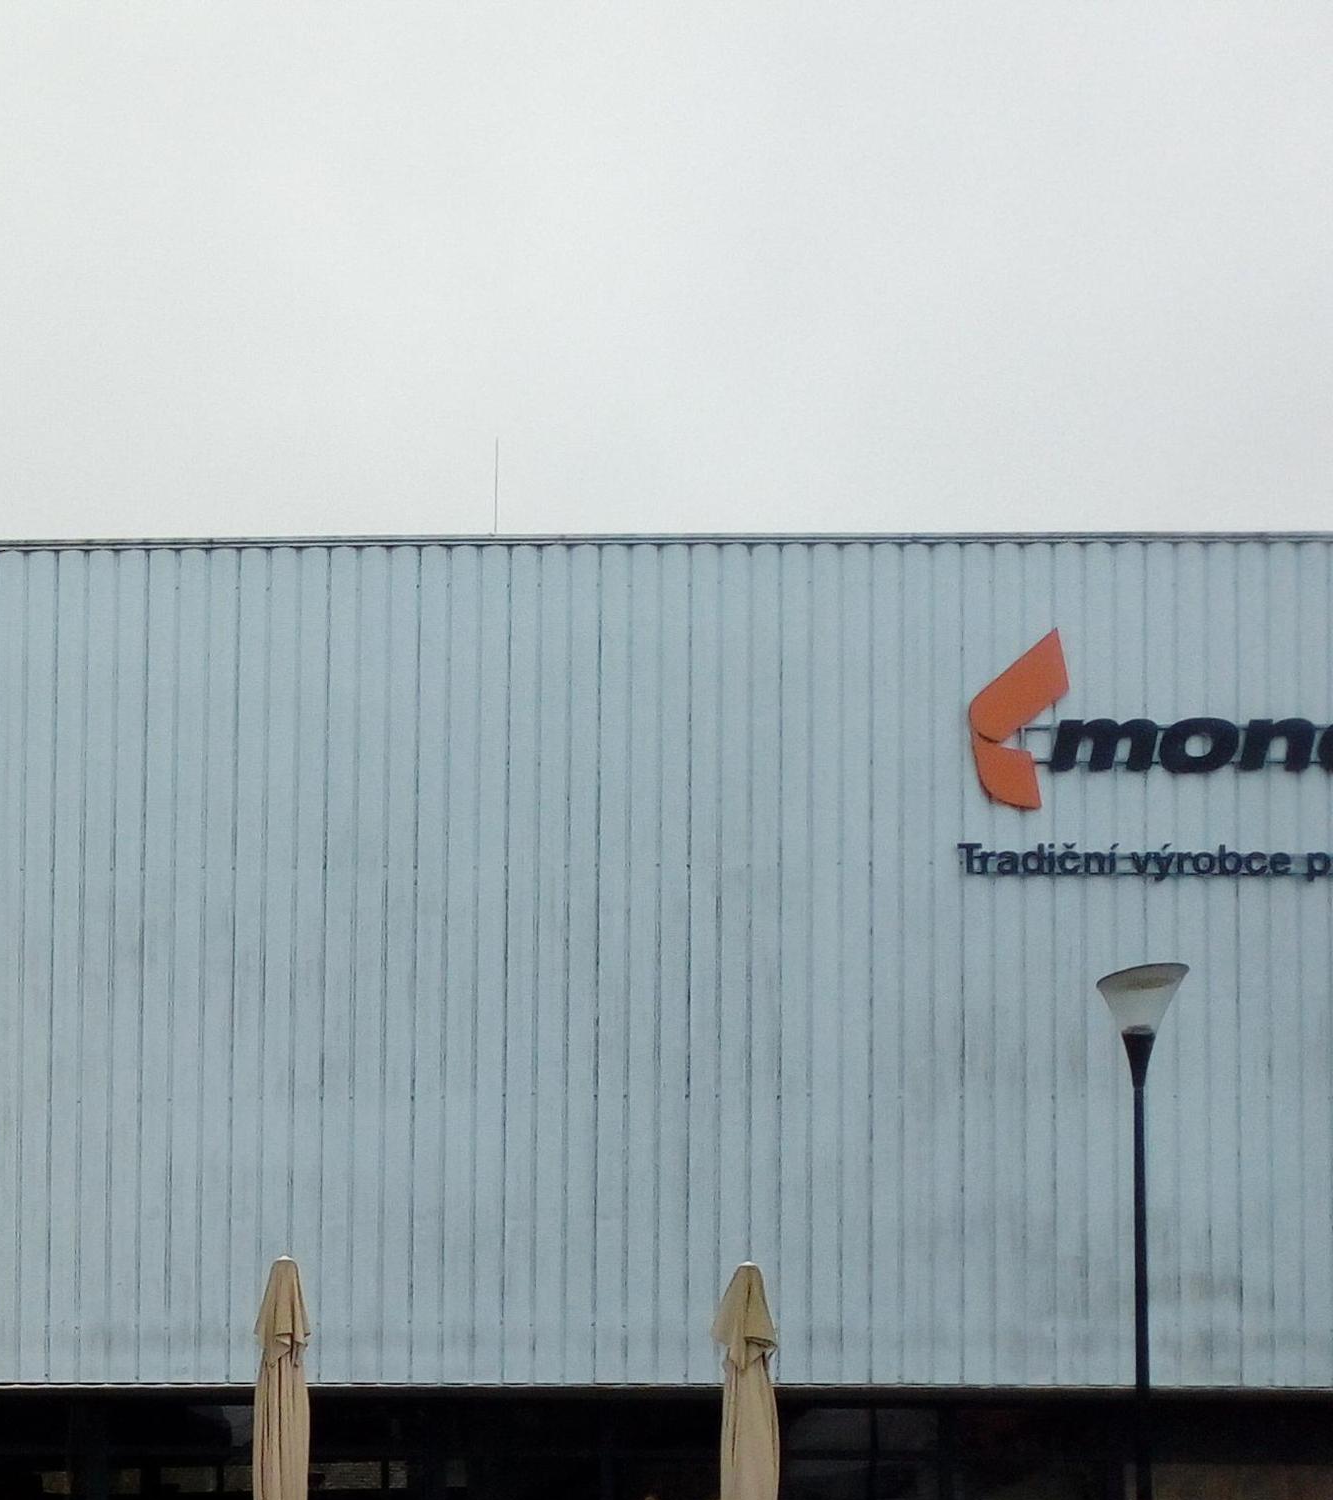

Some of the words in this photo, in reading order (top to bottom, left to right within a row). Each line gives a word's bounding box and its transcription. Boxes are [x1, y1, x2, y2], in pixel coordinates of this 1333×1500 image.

[1049, 717, 1333, 774] mon
[957, 842, 1120, 876] Tradiční
[1132, 843, 1292, 882] výrobce
